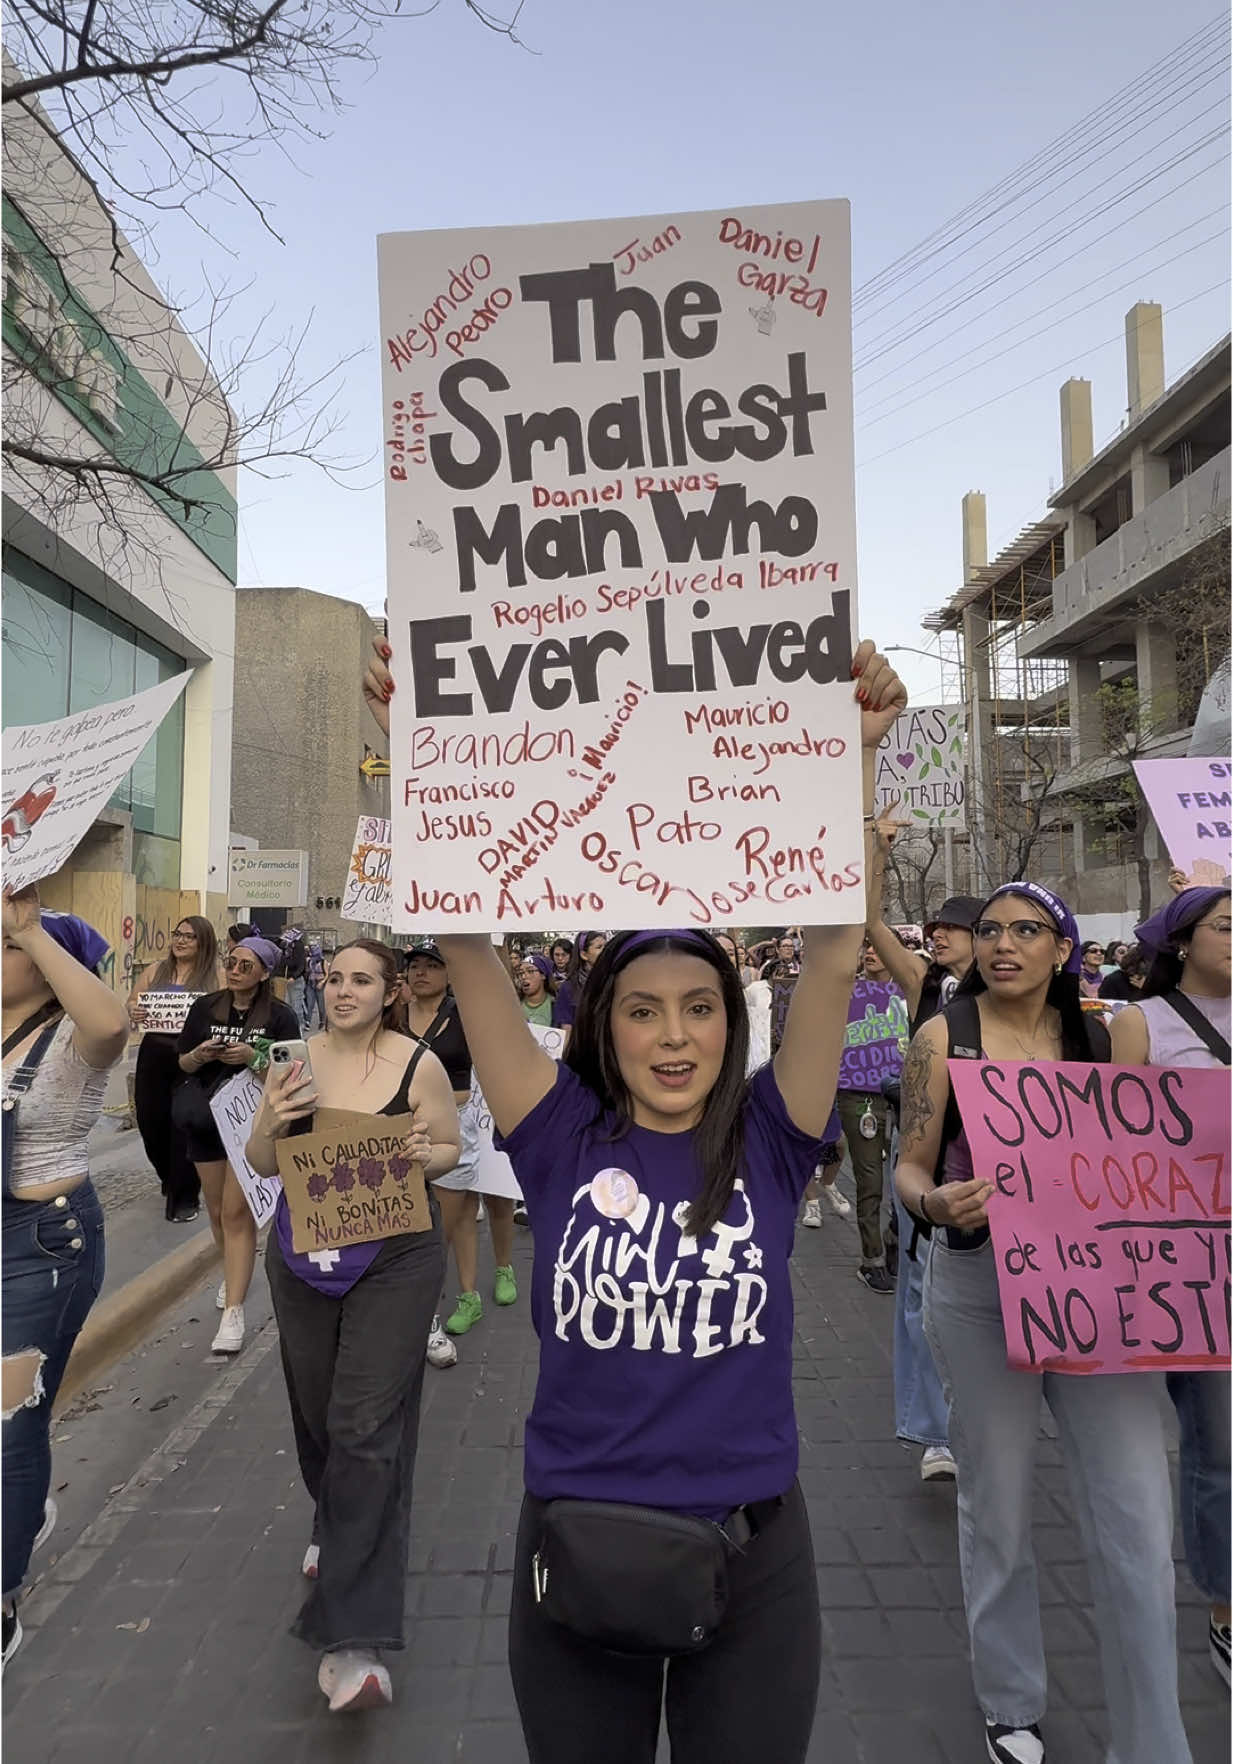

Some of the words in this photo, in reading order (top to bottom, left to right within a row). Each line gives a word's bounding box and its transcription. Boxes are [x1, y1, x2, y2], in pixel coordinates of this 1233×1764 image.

[613, 224, 681, 275] Juan
[718, 217, 821, 273] Daniel
[386, 253, 491, 373] Alejandro
[519, 262, 722, 363] The
[737, 262, 828, 317] Garza
[388, 400, 410, 481] Rodrigo
[429, 351, 828, 491] Smallest
[532, 480, 625, 508] Daniel
[635, 472, 718, 501] Rivas
[453, 503, 643, 592] Man
[649, 482, 818, 564] Who
[492, 594, 587, 637] Rogelio
[597, 568, 744, 613] Sepúlveda
[759, 561, 839, 589] Ibarra
[410, 614, 631, 719] Ever
[646, 588, 856, 693] Lived
[684, 697, 790, 734] Mauricio
[412, 720, 575, 770] Brandon
[713, 729, 846, 775] Alejandro
[405, 777, 515, 807] Francisco
[688, 773, 781, 803] Brian
[907, 781, 965, 808] TRIBU
[416, 810, 492, 842] Jesus
[478, 800, 559, 874] DAVID
[626, 803, 722, 851] Pato
[735, 825, 827, 879] René
[581, 831, 688, 906] Oscar
[405, 880, 482, 914] Juan
[496, 877, 605, 920] Arturo
[210, 1025, 228, 1034] THE
[225, 1095, 248, 1130] NO
[980, 1065, 1193, 1147] SOMOS
[995, 1152, 1034, 1203] el
[1070, 1152, 1232, 1219] CORAZ
[315, 1220, 373, 1245] NUNCA
[1005, 1232, 1041, 1275] de
[1056, 1233, 1102, 1272] las
[1122, 1238, 1177, 1281] que
[554, 1272, 767, 1358] POWER
[1020, 1285, 1099, 1366] NO
[1115, 1280, 1232, 1354] EST
